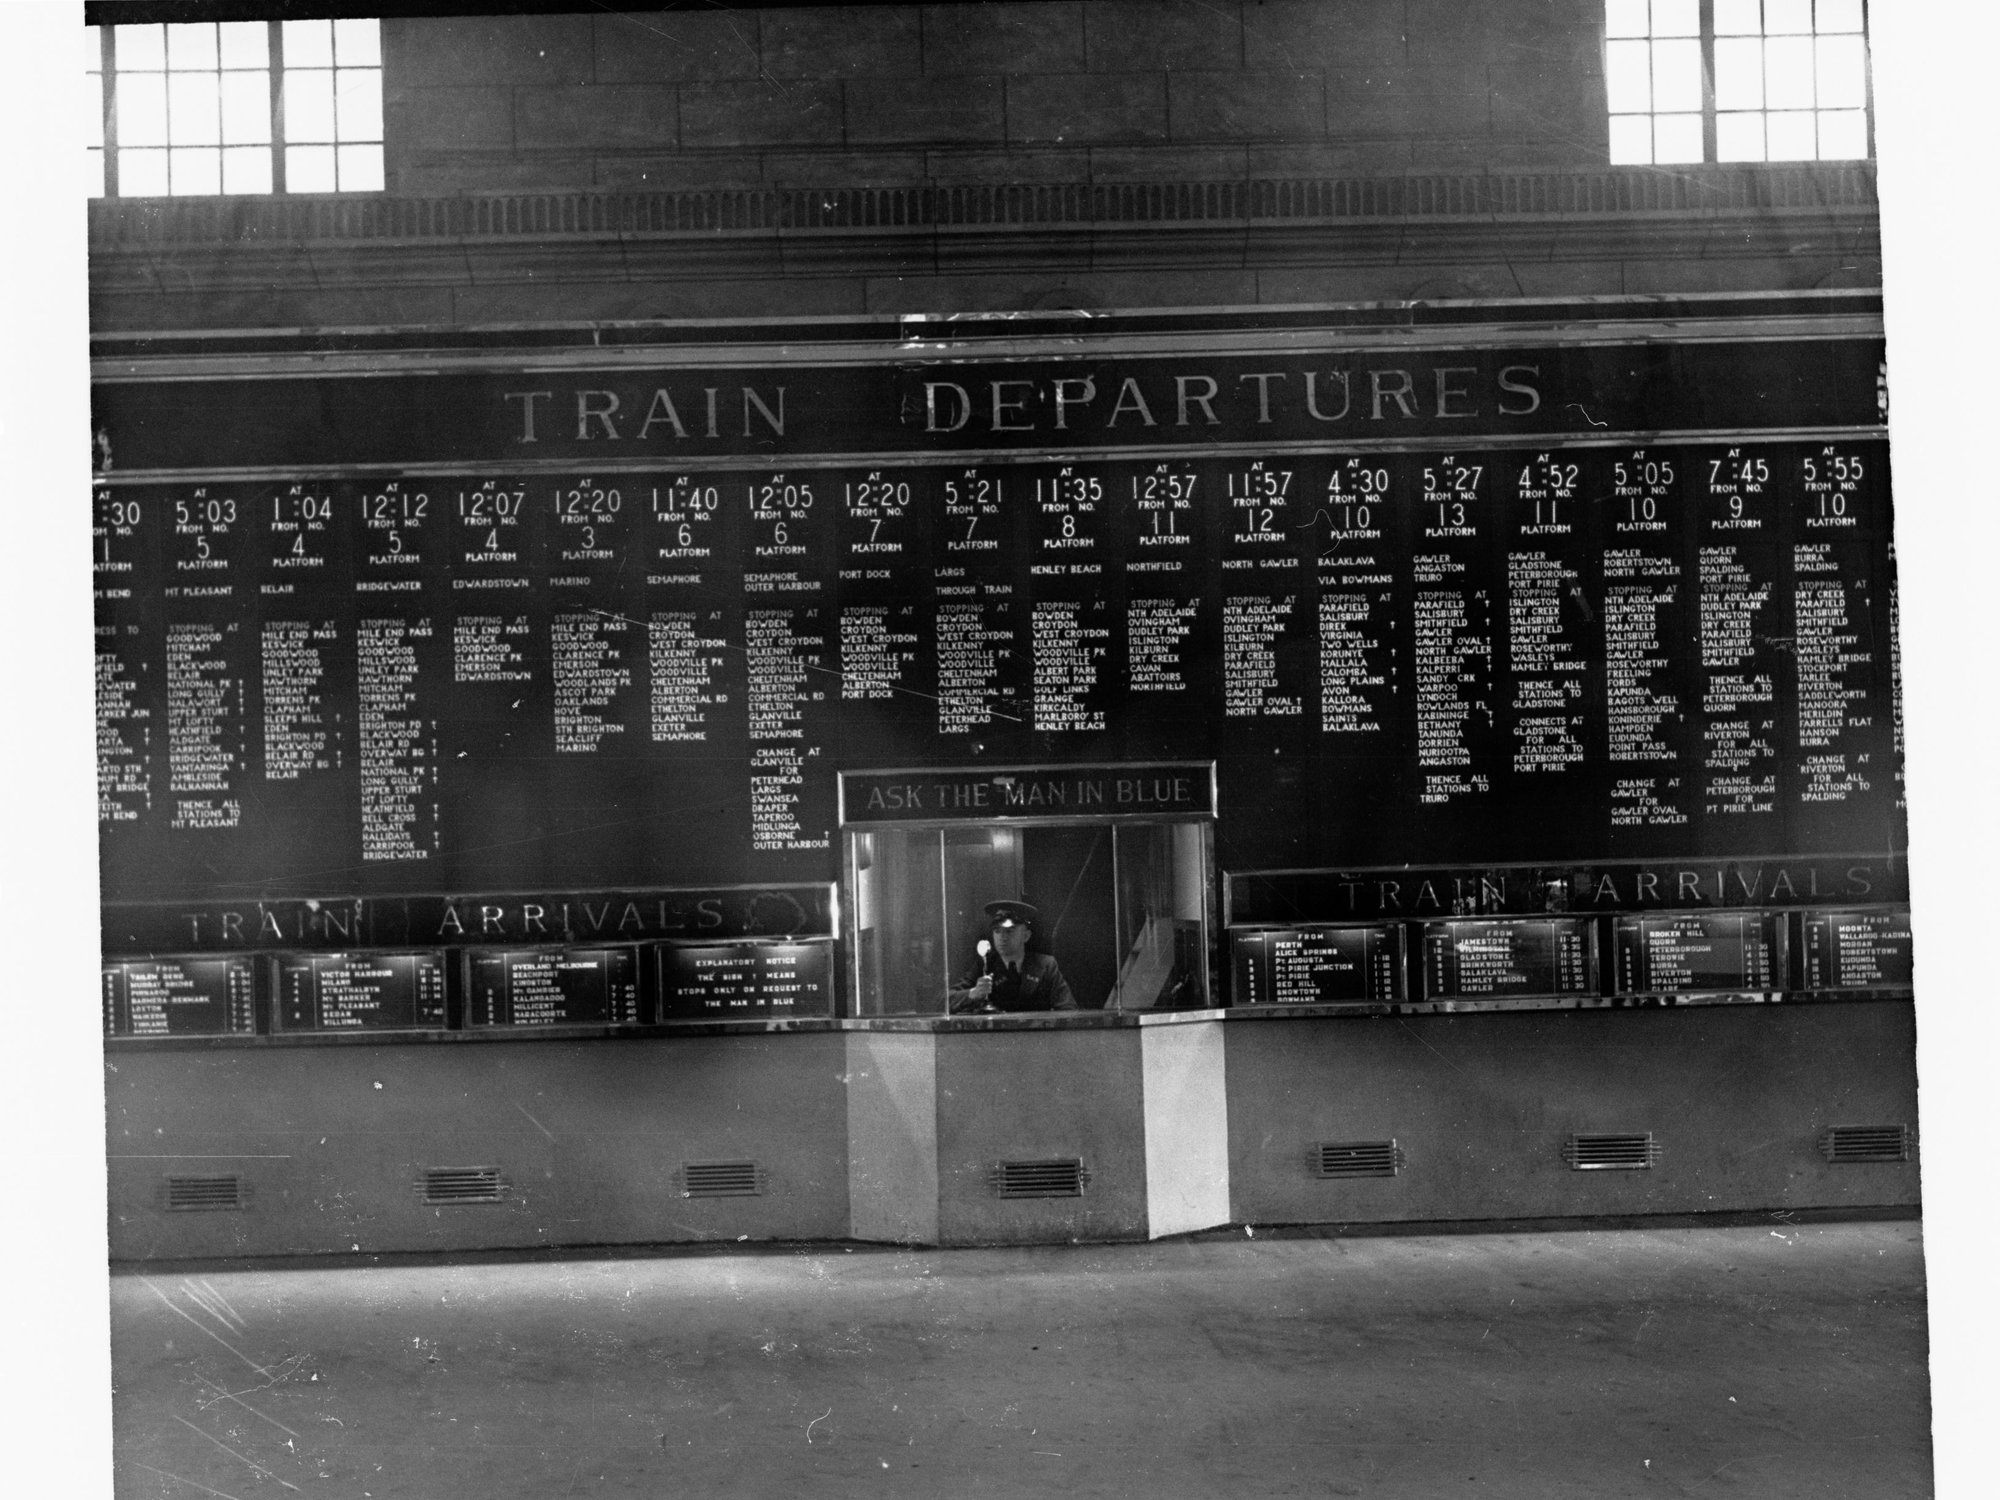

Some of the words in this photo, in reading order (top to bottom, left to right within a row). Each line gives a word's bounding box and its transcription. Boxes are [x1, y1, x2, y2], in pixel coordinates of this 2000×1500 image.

[504, 387, 786, 443] TRAIN
[923, 365, 1542, 431] DEPARTURES
[1133, 475, 1197, 499] 12:57
[1229, 471, 1292, 497] 11:57
[846, 482, 910, 507] 12:20
[1037, 477, 1102, 502] 11:35
[556, 489, 621, 514] 12:20
[653, 487, 718, 512] 11:40
[749, 485, 813, 510] 12:05
[363, 493, 428, 519] 12:12
[460, 492, 525, 516] 12:07
[1631, 497, 1656, 521] 10
[1730, 496, 1743, 519] 9
[1821, 493, 1845, 516] 10
[1346, 505, 1370, 529] 10
[1440, 503, 1465, 526] 13
[1536, 500, 1556, 524] 11
[1152, 511, 1174, 534] 11
[1249, 508, 1273, 532] 12
[1712, 519, 1761, 529] PLATFORM
[176, 524, 203, 533] FROM
[212, 523, 228, 532] NO.
[870, 519, 882, 542] 7
[967, 516, 978, 540] 7
[1062, 515, 1075, 538] 8
[1521, 524, 1571, 534] PLATFORM
[581, 525, 595, 549] 3
[678, 523, 691, 546] 6
[775, 521, 788, 545] 6
[1235, 533, 1285, 543] PLATFORM
[292, 533, 305, 556] 4
[389, 530, 401, 554] 5
[485, 528, 498, 551] 4
[197, 536, 210, 560] 5
[948, 540, 998, 550] PLATFORM
[465, 552, 517, 562] PLATFORM
[659, 548, 710, 558] PLATFORM
[1794, 553, 1824, 563] BURRA
[1222, 560, 1253, 569] NORTH
[1260, 558, 1298, 568] GAWLER
[1318, 556, 1375, 566] BALAKLAVA
[1413, 554, 1450, 563] GAWLER
[1604, 558, 1671, 567] ROBERTSTOWN
[1699, 556, 1732, 565] QUORN
[177, 560, 228, 570] PLATFORM
[1031, 565, 1066, 574] HENLEY
[1070, 564, 1101, 574] BEACH
[1126, 561, 1182, 571] NORTHFIELD
[1414, 563, 1465, 573] ANGASTON
[1508, 560, 1562, 570] GLADSTONE
[1699, 565, 1744, 574] SPALDING
[744, 572, 798, 582] SEMAPHORE
[839, 570, 862, 579] PORT
[866, 570, 891, 579] DOCK
[934, 568, 965, 577] LARGS
[1414, 573, 1443, 582] TRURO
[1508, 569, 1578, 579] PETERBOROUGH
[453, 579, 529, 589] EDWARDSTOWN
[550, 577, 591, 586] MARINO
[647, 574, 701, 584] SEMAPHORE
[1318, 576, 1336, 585] VIA
[1342, 574, 1392, 584] BOWMANS
[165, 587, 179, 596] MT
[183, 586, 232, 596] PLEASANT
[260, 584, 294, 594] BELAIR
[356, 581, 421, 591] BRIDGEWATER
[744, 582, 774, 592] OUTER
[778, 581, 821, 591] HARBOUR
[936, 586, 976, 595] THROUGH
[984, 585, 1012, 594] TRAIN
[1319, 603, 1370, 612] PARAFIELD
[1128, 617, 1180, 627] OVINGHAM
[1319, 622, 1346, 631] DIREK
[841, 635, 868, 644] WEST
[872, 634, 917, 643] CROYDON
[1129, 636, 1179, 645] ISLINGTON
[1320, 631, 1363, 640] VIRGINIA
[455, 653, 505, 663] CLARENCE
[510, 653, 522, 661] PK
[1129, 655, 1148, 663] DRY
[1153, 654, 1179, 663] CREEK
[1320, 658, 1368, 667] MALLALA
[841, 662, 898, 672] WOODVILLE
[1797, 663, 1847, 673] STOCKPORT
[1131, 672, 1181, 682] ABATTOIRS
[1321, 668, 1367, 677] CALOMBA
[1607, 669, 1651, 678] FREELING
[167, 680, 215, 689] NATIONAL
[220, 679, 231, 688] PK
[1034, 676, 1069, 685] SEATON
[1073, 675, 1097, 684] PARK
[1322, 686, 1350, 695] AVON
[1798, 681, 1843, 691] RIVERTON
[554, 688, 585, 697] ASCOT
[591, 687, 616, 696] PARK
[1607, 687, 1651, 696] KAPUNDA
[1034, 694, 1073, 703] GRANGE
[1417, 693, 1457, 702] LYNDOCH
[1034, 703, 1085, 712] KIRKCALDY
[1799, 700, 1847, 709] MANOORA
[652, 723, 686, 732] EXETER
[1799, 718, 1843, 728] FARRELLS
[1849, 717, 1872, 727] FLAT
[359, 730, 420, 739] BLACKWOOD
[1418, 729, 1463, 738] TANUNDA
[1609, 733, 1652, 742] EUDUNDA
[756, 748, 796, 757] CHANGE
[808, 747, 820, 756] AT
[171, 772, 221, 782] AMBLESIDE
[751, 775, 803, 785] PETERHEAD
[752, 794, 799, 803] SWANSEA
[867, 785, 923, 809] ASK
[934, 783, 990, 807] THE
[1005, 781, 1065, 806] MAN
[1077, 780, 1102, 804] IN
[1116, 778, 1192, 802] BLUE
[177, 800, 212, 810] THENCE
[222, 800, 240, 810] ALL
[753, 813, 794, 822] TAPEROO
[362, 823, 405, 832] ALDGATE
[363, 850, 427, 860] BRIDGEWATER
[1594, 866, 1872, 903] ARRIVALS
[181, 909, 348, 942] TRAIN
[435, 898, 723, 935] ARRIVALS
[1275, 941, 1302, 949] PERTH
[766, 957, 797, 966] NOTICE
[766, 971, 796, 979] MEANS
[1497, 974, 1527, 983] BRIDGE
[763, 984, 801, 993] REQUEST
